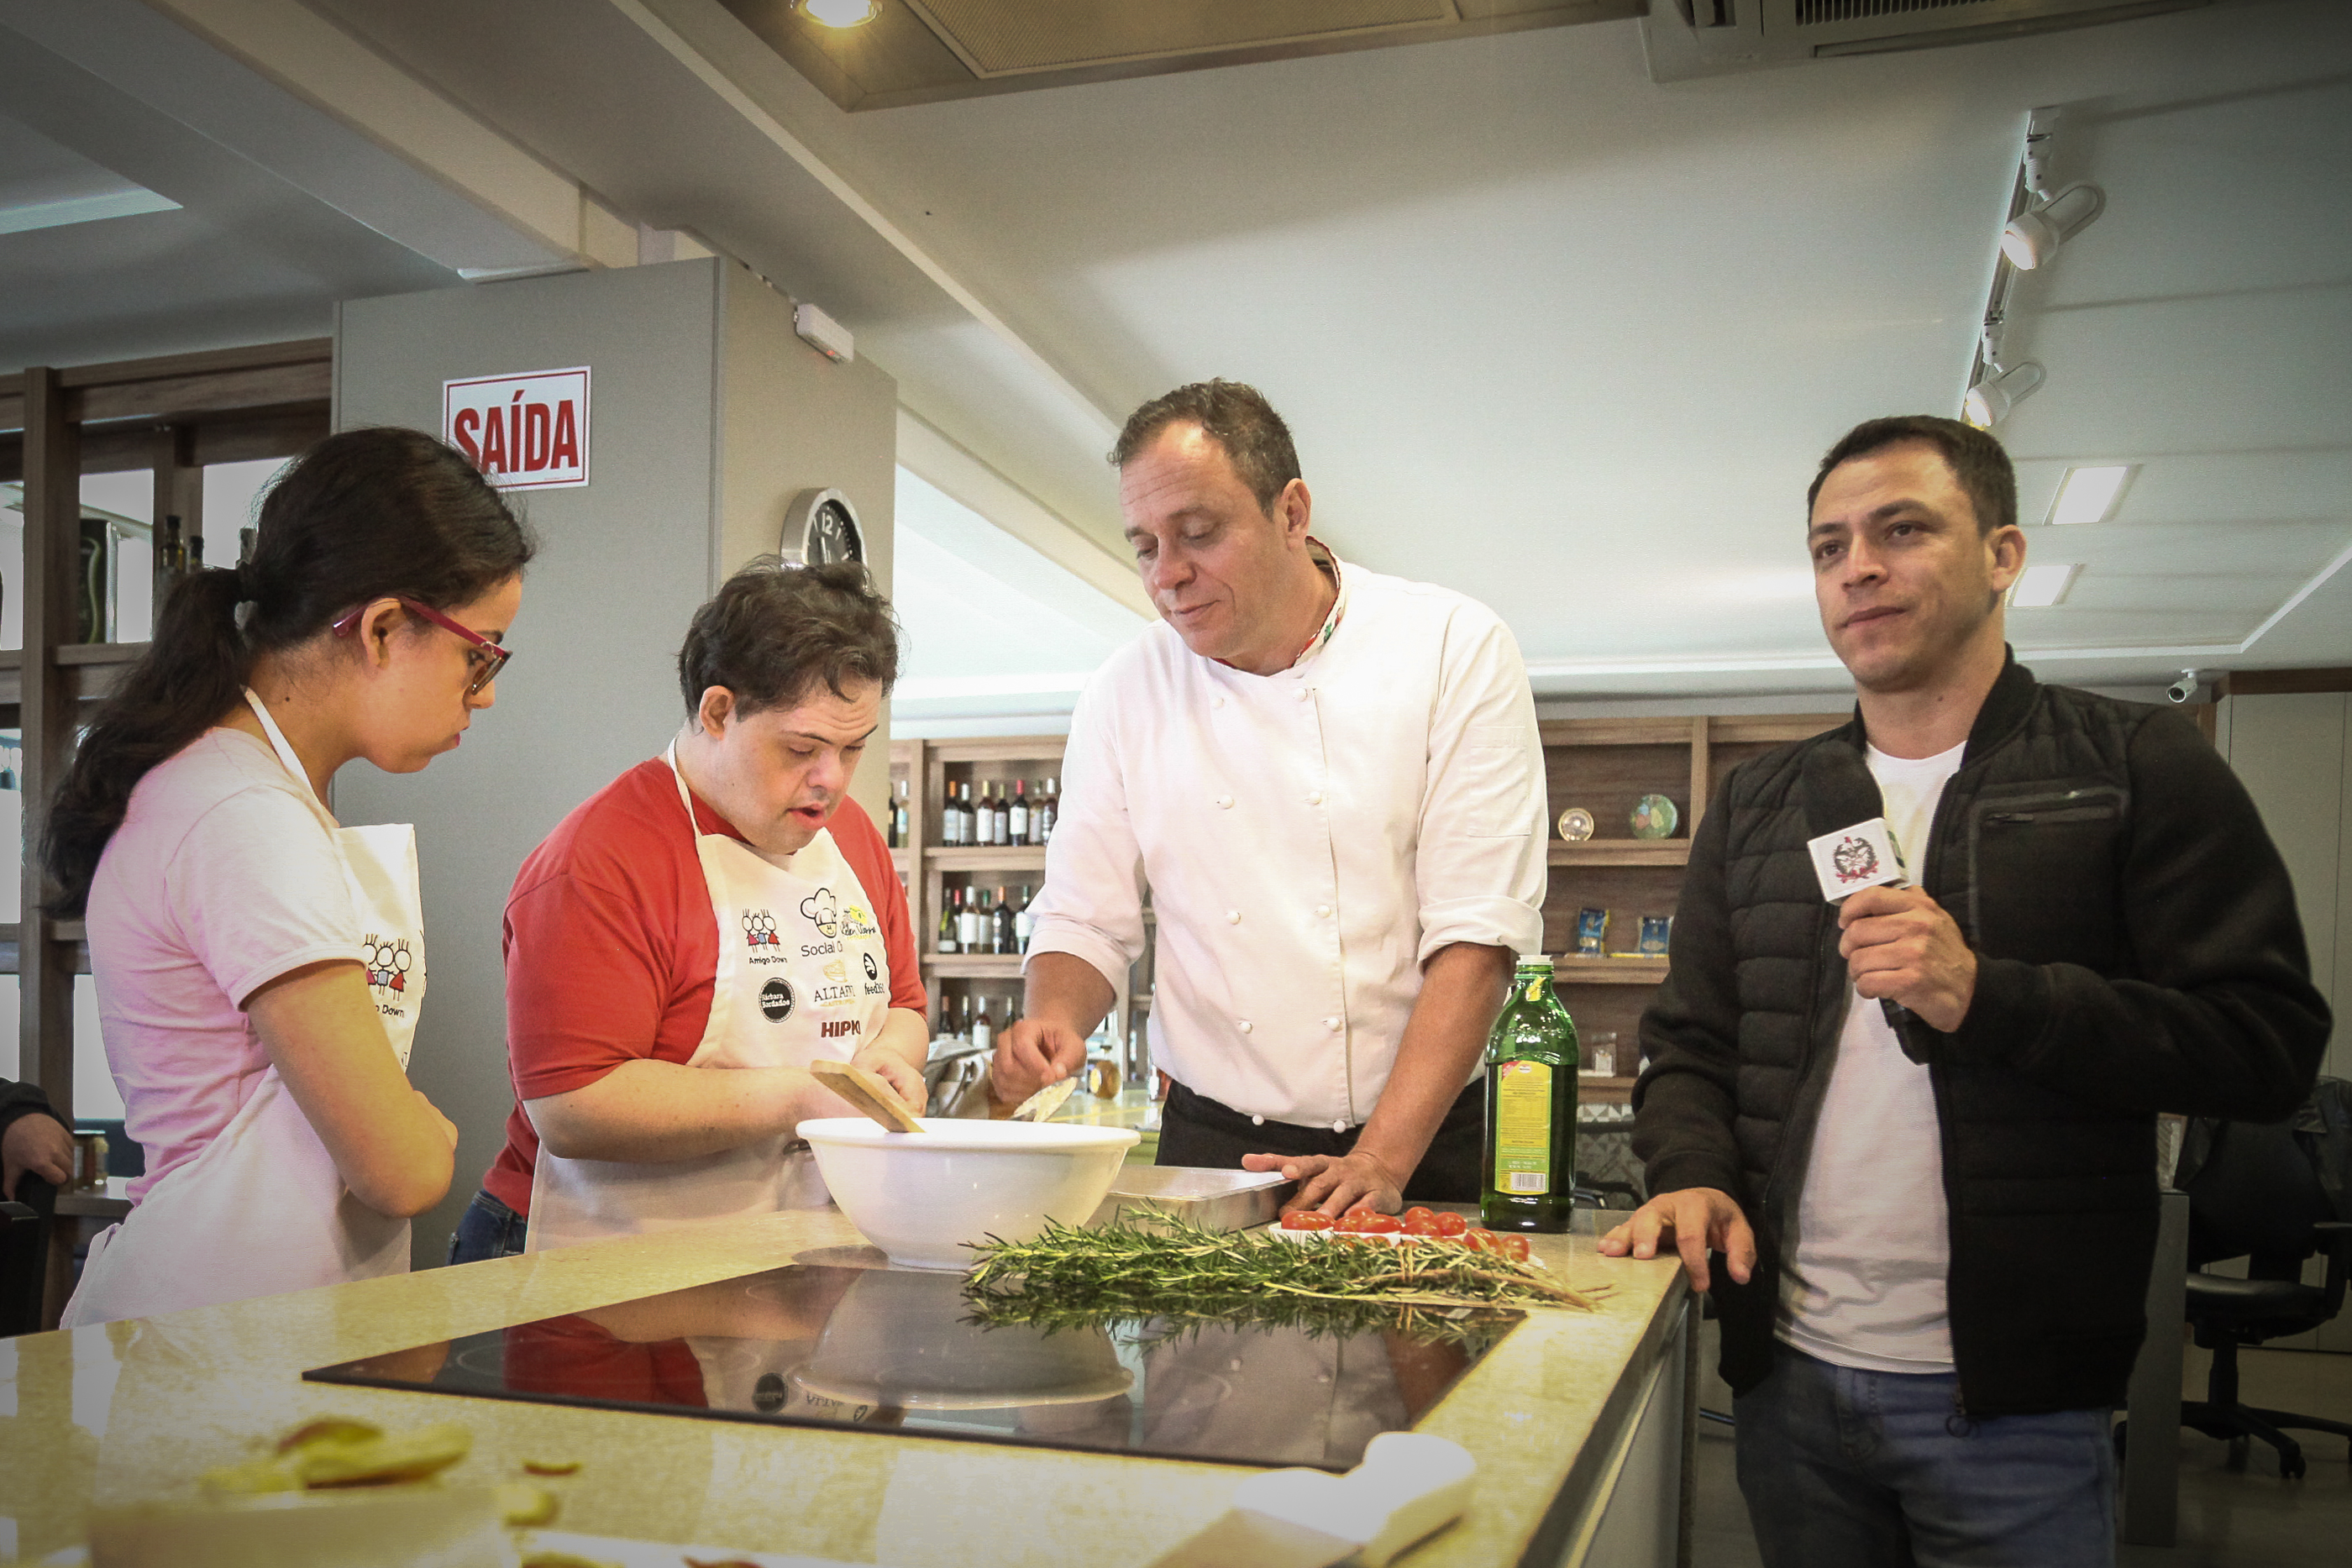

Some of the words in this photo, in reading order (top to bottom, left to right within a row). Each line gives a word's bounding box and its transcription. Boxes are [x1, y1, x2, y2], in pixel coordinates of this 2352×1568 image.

[454, 389, 579, 475] SAÍDA
[822, 511, 832, 535] 12
[801, 941, 835, 957] Social
[749, 957, 770, 965] Amigo
[382, 1004, 404, 1017] Down
